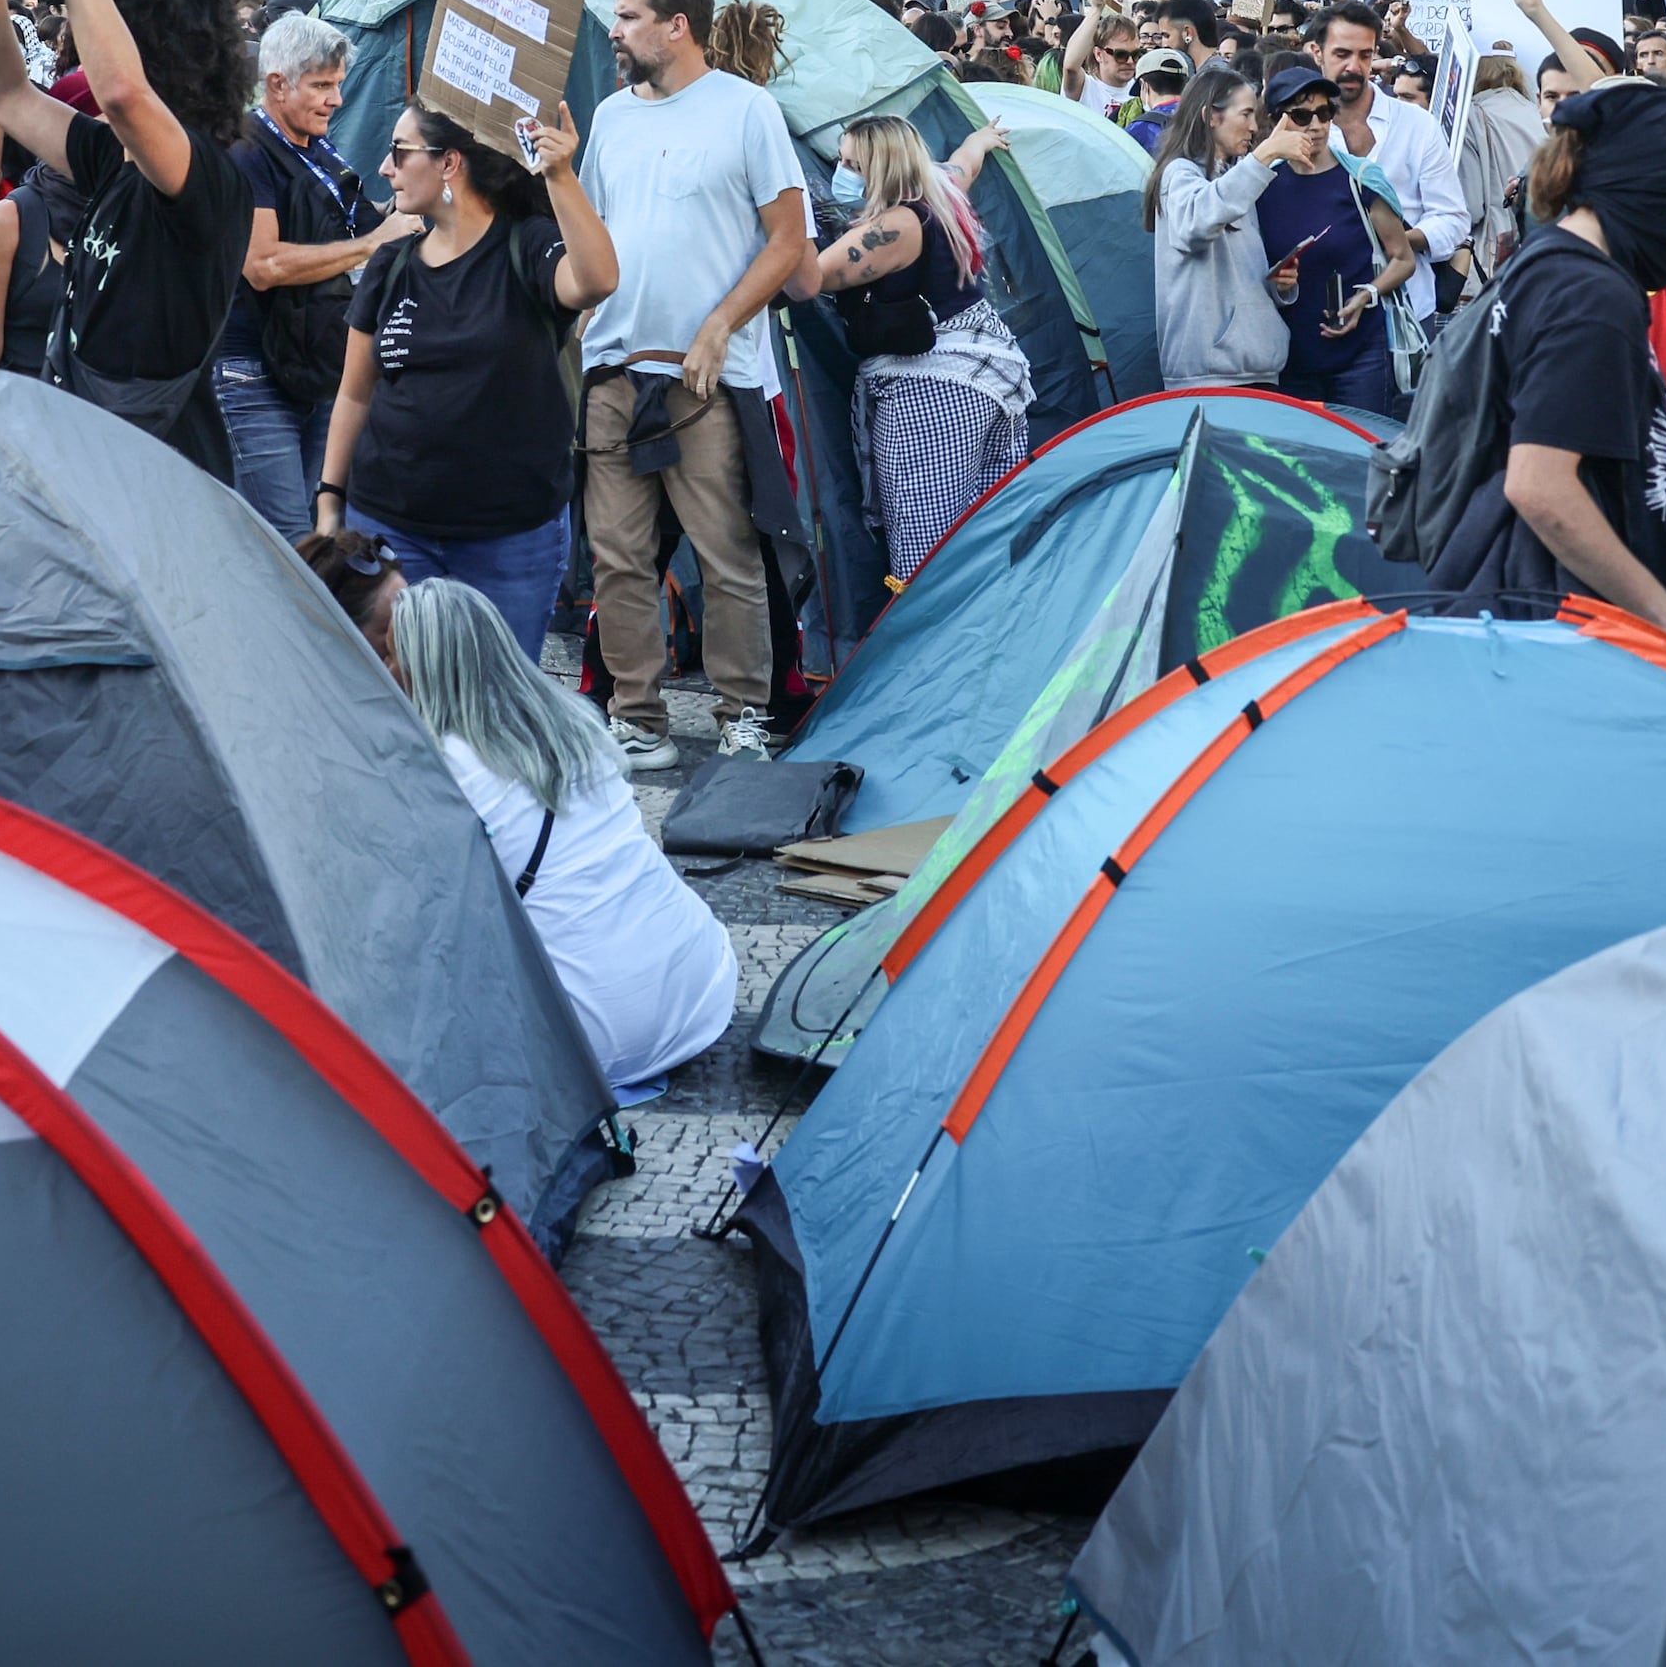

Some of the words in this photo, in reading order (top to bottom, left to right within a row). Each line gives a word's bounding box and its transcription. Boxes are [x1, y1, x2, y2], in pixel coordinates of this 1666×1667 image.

[499, 6, 513, 20] NO
[538, 8, 547, 21] O
[443, 30, 483, 61] OCUPADO
[483, 52, 507, 75] PELO
[447, 14, 466, 32] MAS
[466, 22, 478, 40] JÁ
[478, 31, 512, 58] ESTAVA
[493, 77, 508, 94] DO
[508, 84, 539, 111] LOBBY
